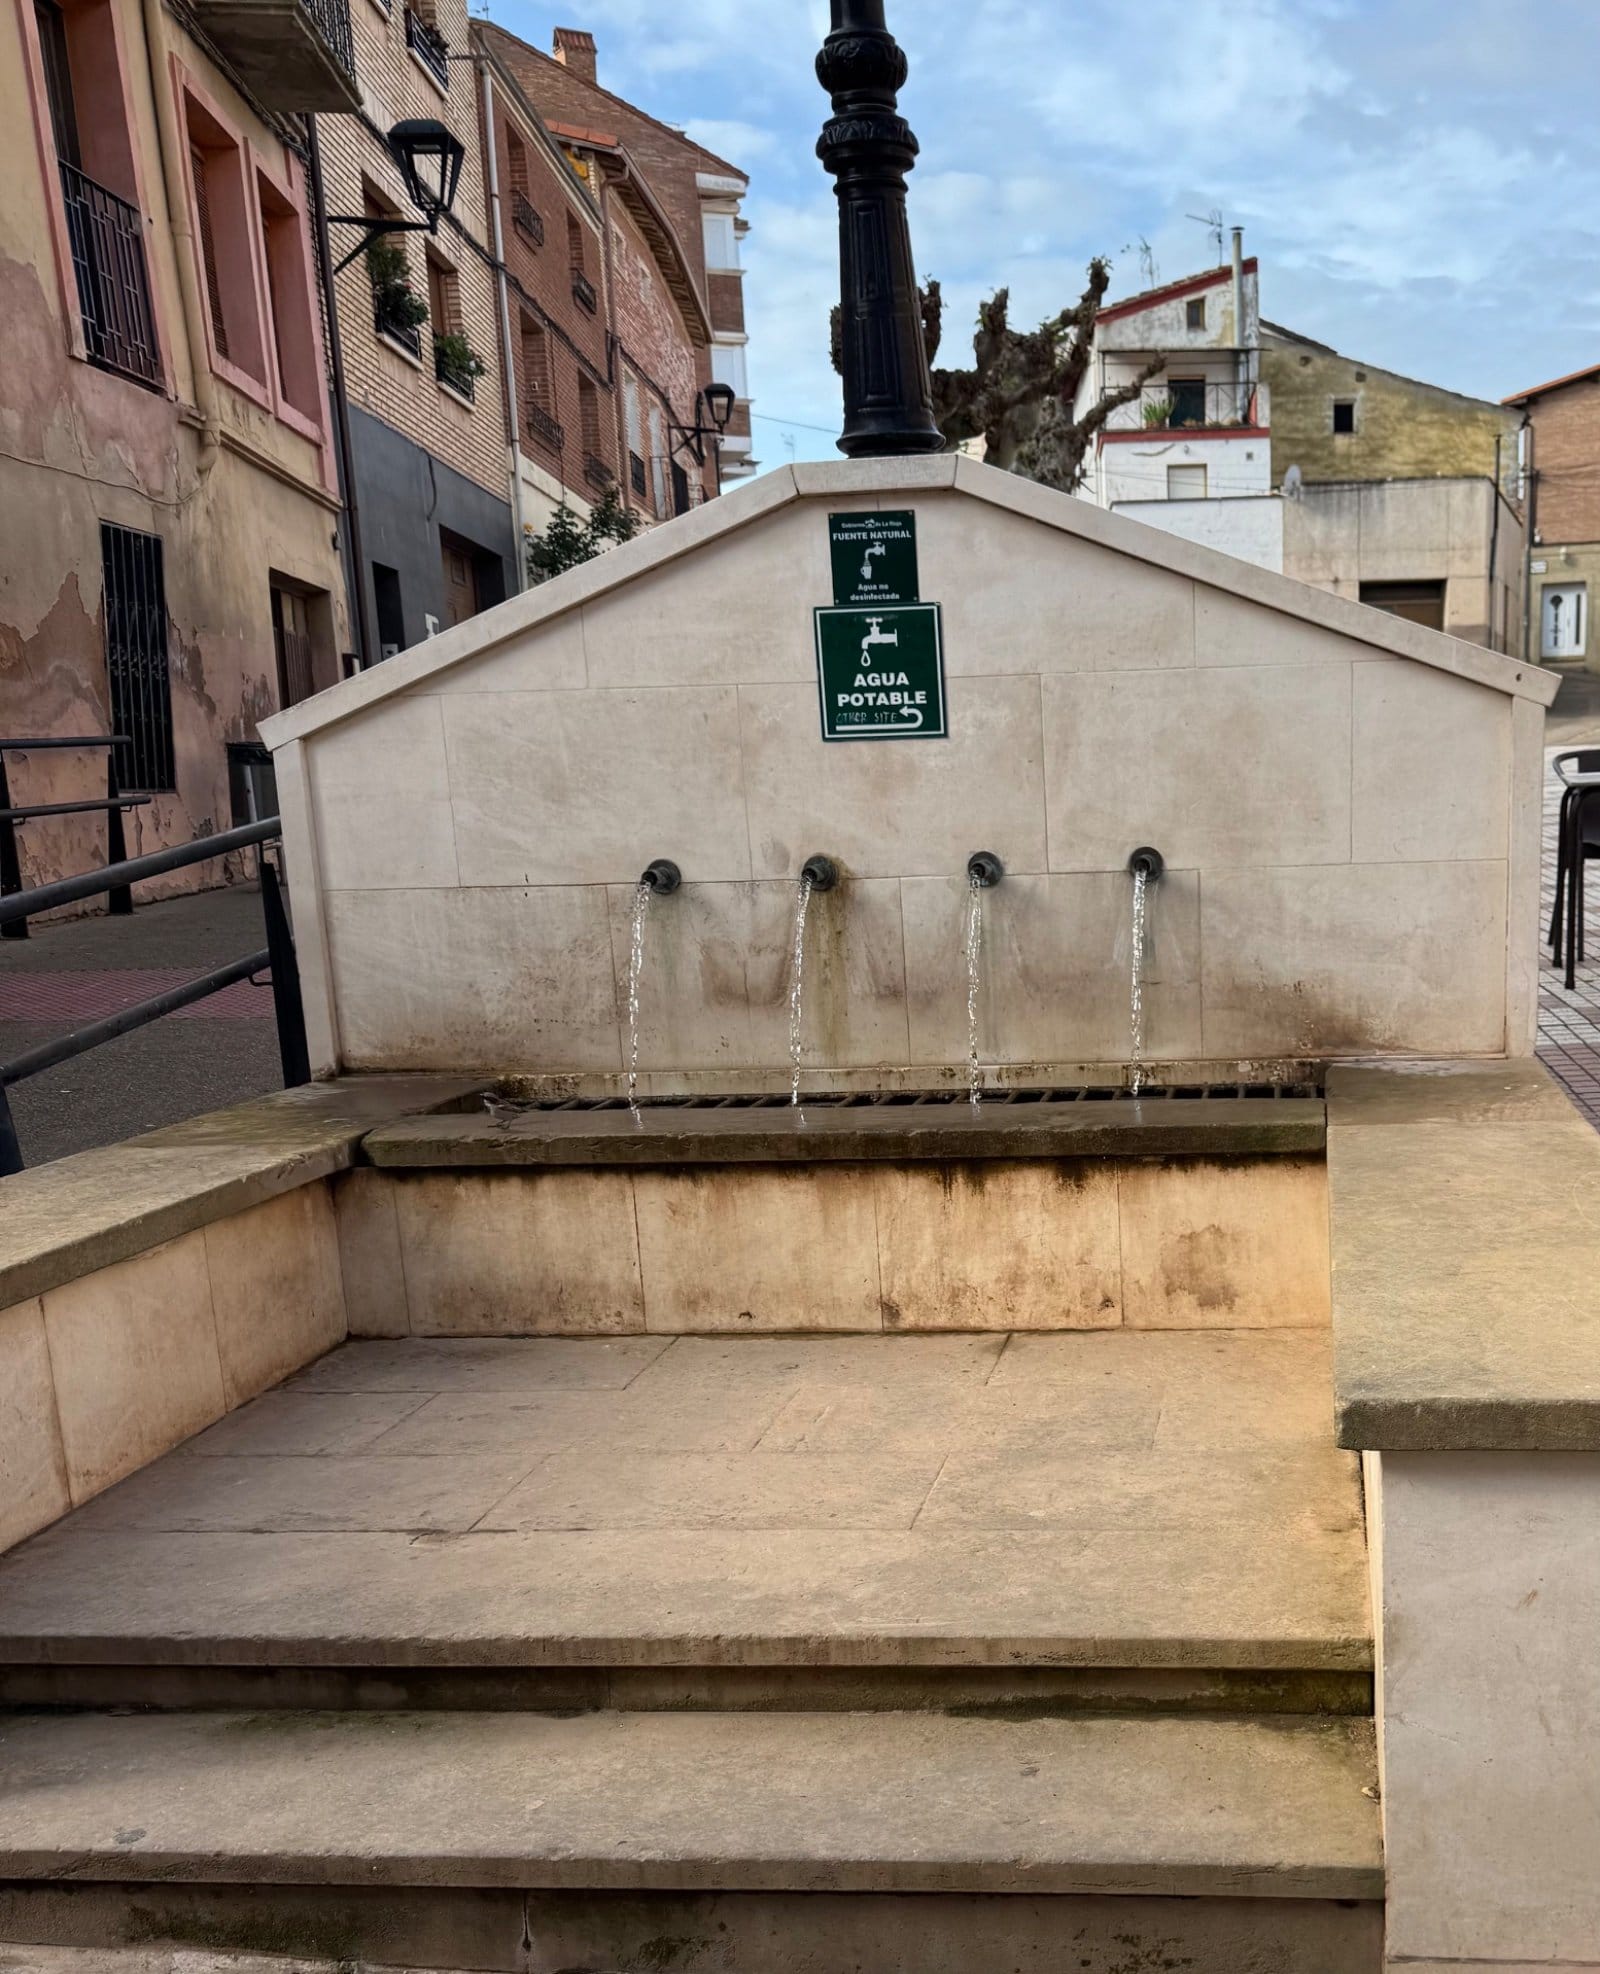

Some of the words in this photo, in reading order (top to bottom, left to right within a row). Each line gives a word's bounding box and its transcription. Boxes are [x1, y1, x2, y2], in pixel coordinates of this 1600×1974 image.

[833, 532, 868, 540] FUENTE
[870, 530, 911, 539] NATURAL
[853, 672, 910, 687] AGUA
[837, 691, 927, 707] POTABLE
[874, 711, 897, 722] SITE
